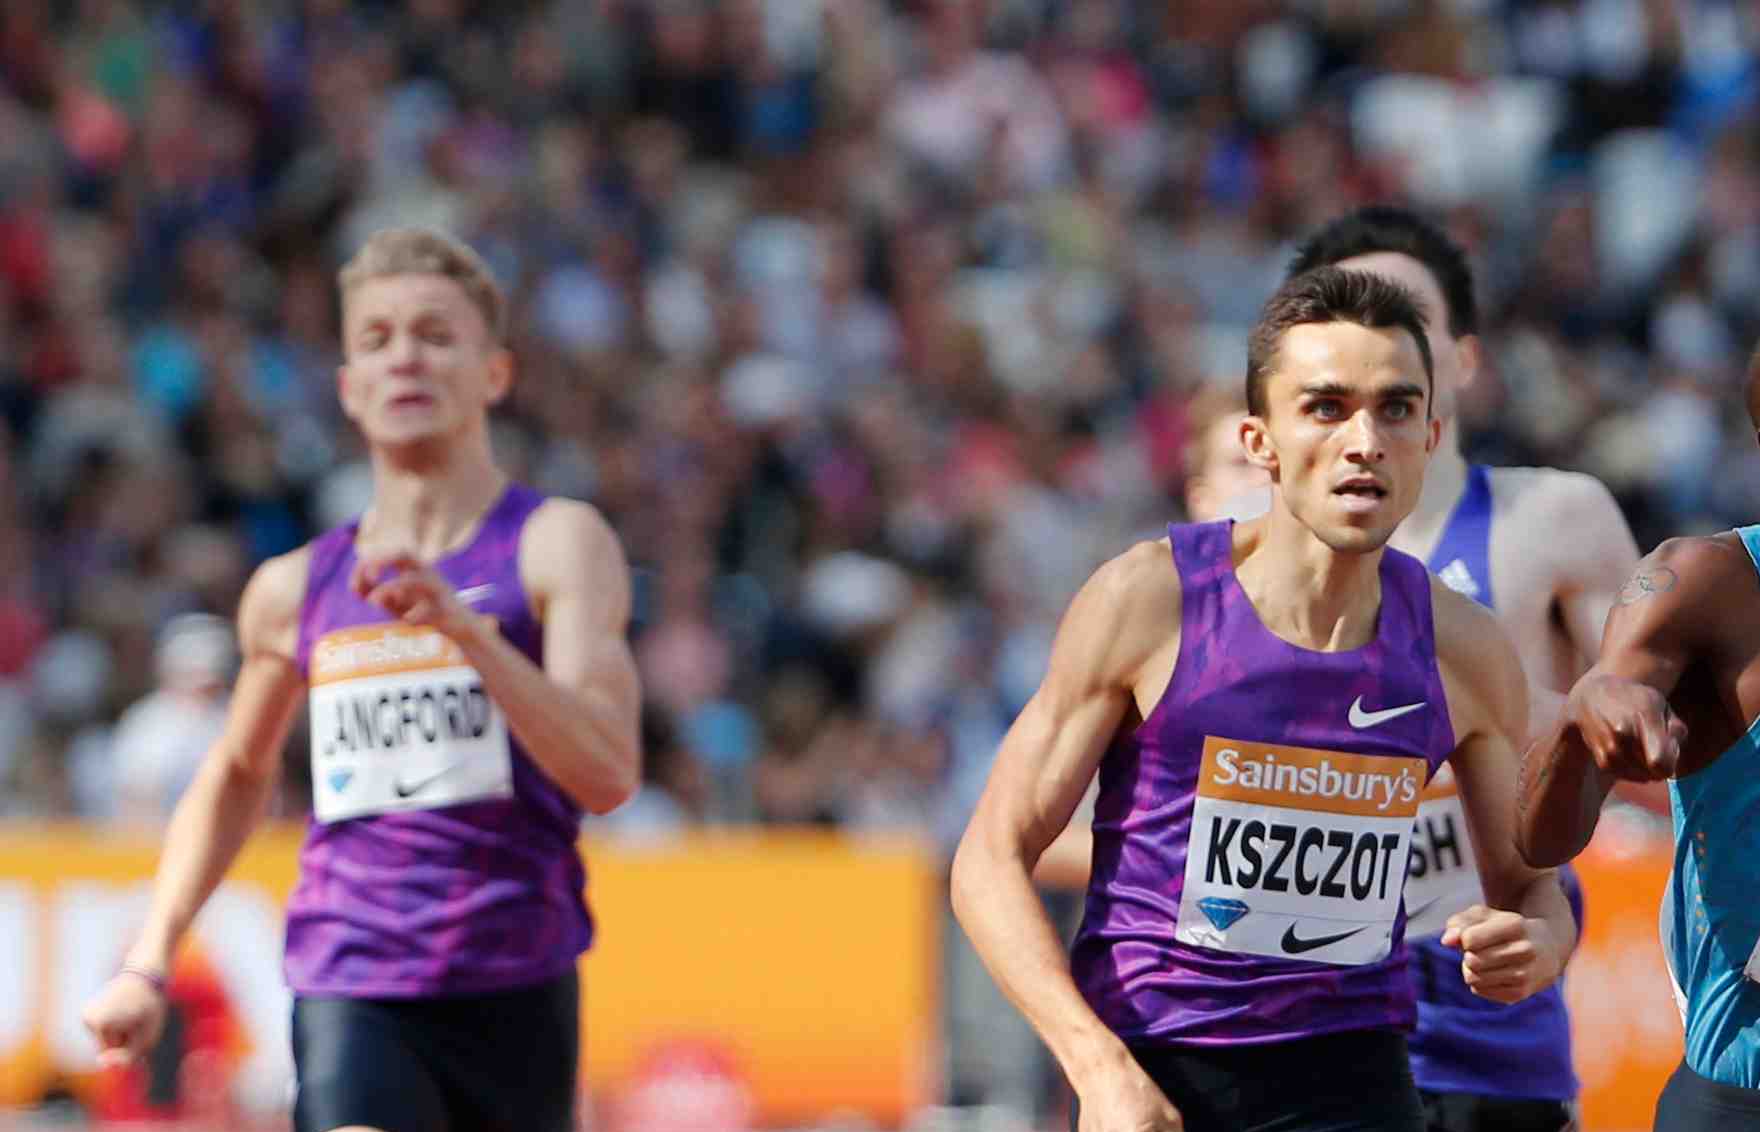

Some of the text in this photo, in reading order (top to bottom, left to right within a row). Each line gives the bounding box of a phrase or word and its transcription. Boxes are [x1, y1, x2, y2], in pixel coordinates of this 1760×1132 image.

[322, 686, 489, 756] ANGFORD
[1212, 748, 1417, 811] Sainsbury's
[1204, 816, 1400, 900] KSZCZOT
